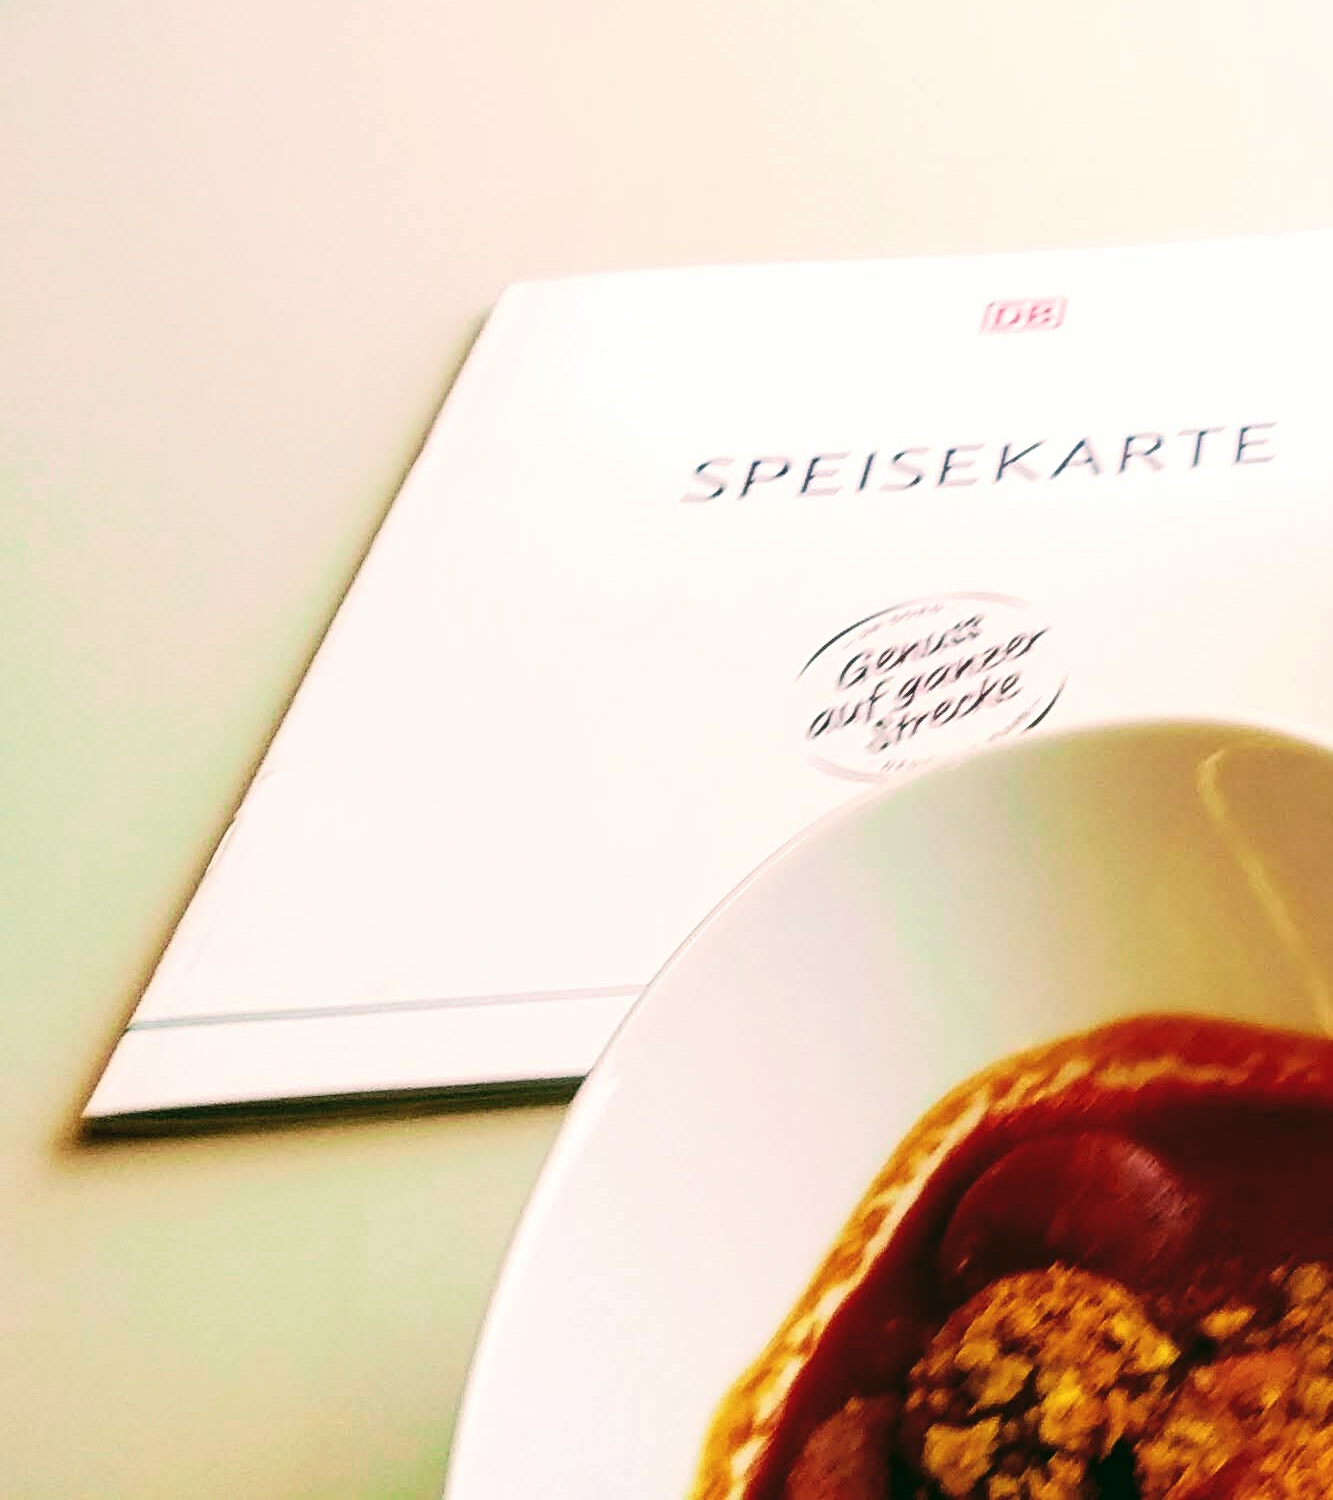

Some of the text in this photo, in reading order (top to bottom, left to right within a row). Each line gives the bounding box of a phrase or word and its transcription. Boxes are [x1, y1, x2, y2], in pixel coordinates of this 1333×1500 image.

[986, 301, 1062, 331] DB
[680, 421, 1278, 503] SPEISEKARTE
[806, 625, 1051, 740] auf ganzer
[836, 613, 984, 691] Genuss
[866, 670, 1025, 754] Strecke
